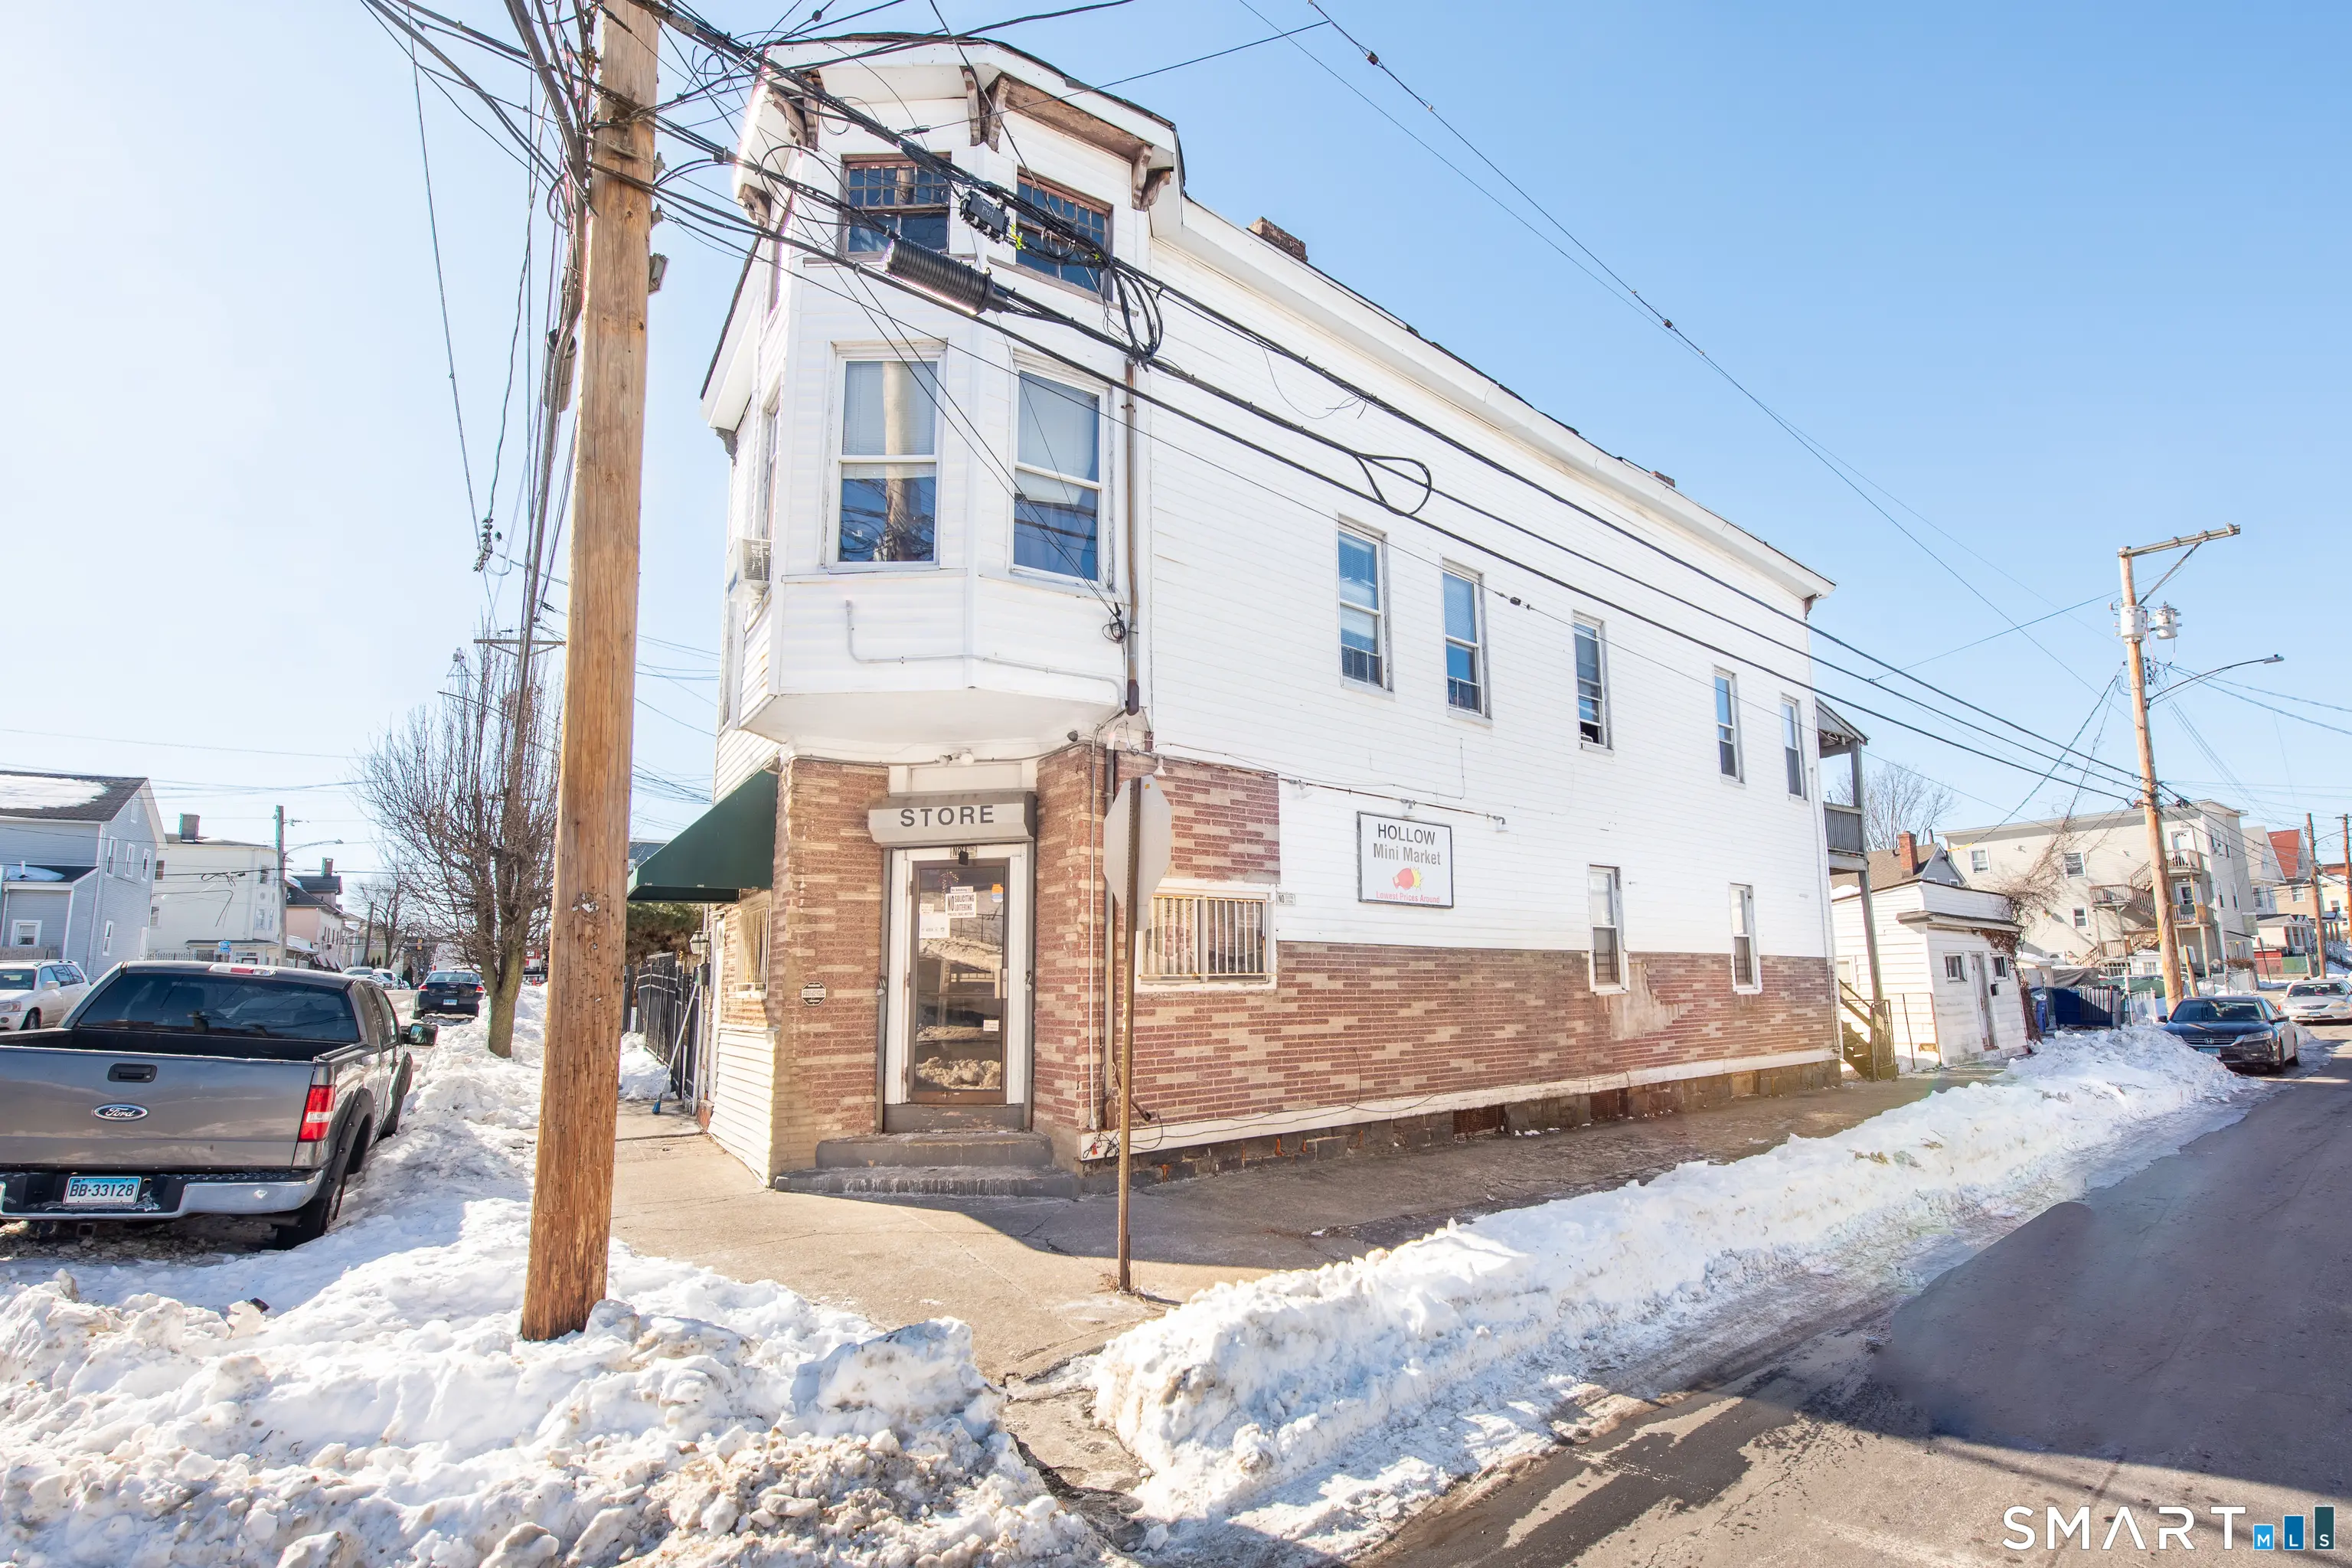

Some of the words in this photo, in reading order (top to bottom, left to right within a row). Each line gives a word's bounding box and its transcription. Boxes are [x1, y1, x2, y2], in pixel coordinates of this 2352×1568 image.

[900, 805, 995, 828] STORE
[1377, 823, 1436, 845] HOLLOW
[1373, 842, 1400, 861] Mini
[1403, 846, 1442, 865] Market
[947, 895, 955, 912] NO
[955, 894, 975, 903] SOLICITING
[1376, 890, 1399, 900] Lowest
[1400, 892, 1419, 902] Prices
[1419, 894, 1440, 904] Around
[955, 903, 972, 912] LOITERING
[105, 1107, 136, 1117] Ford
